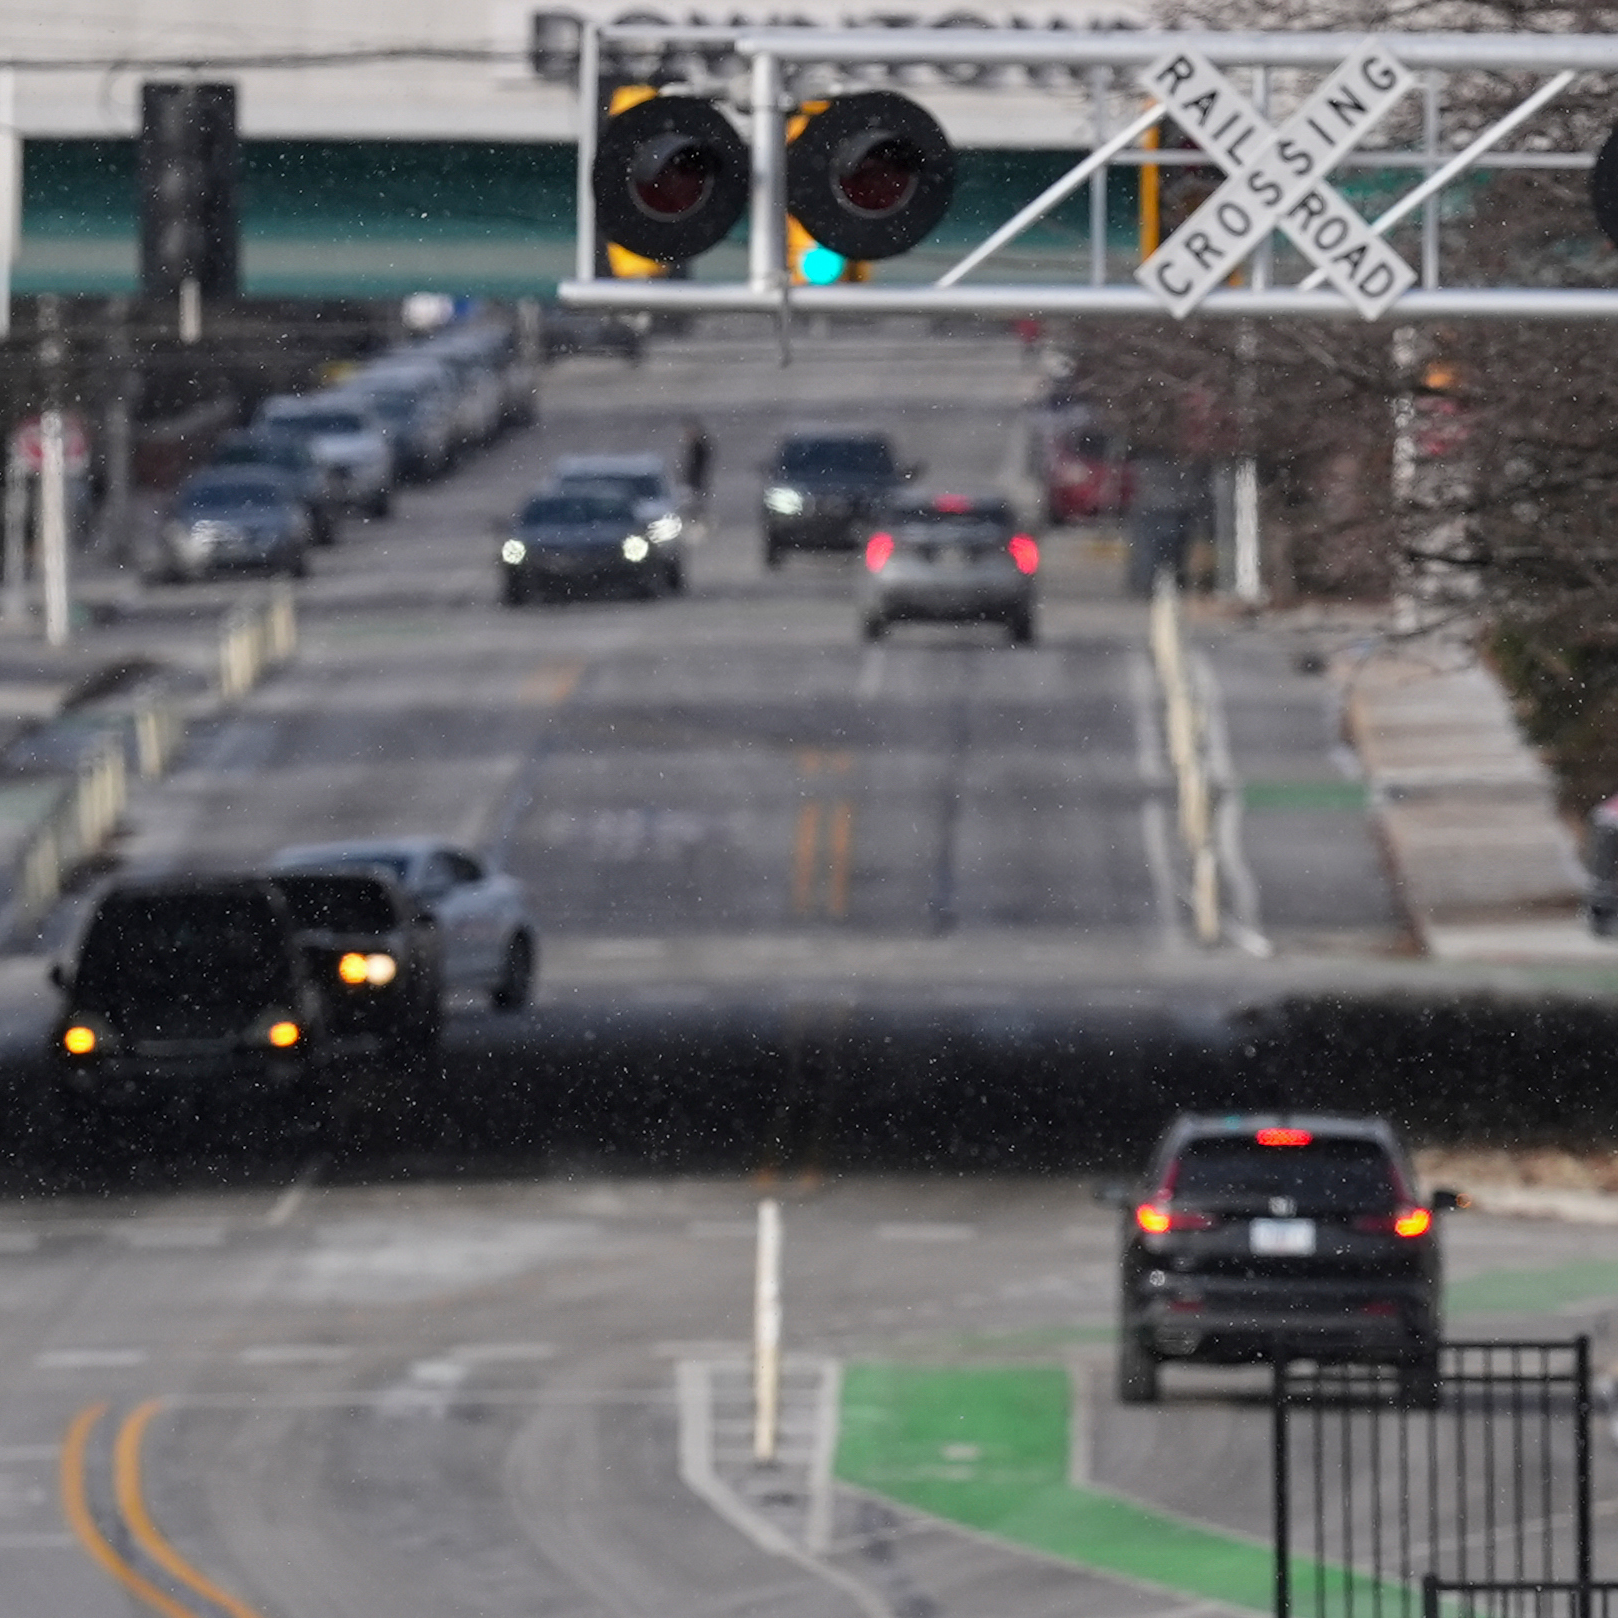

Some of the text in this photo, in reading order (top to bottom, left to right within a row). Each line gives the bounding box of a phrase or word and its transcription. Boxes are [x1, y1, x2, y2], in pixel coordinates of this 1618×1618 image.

[1156, 56, 1397, 298] CROSSING
[1157, 55, 1394, 298] RAIL ROAD
